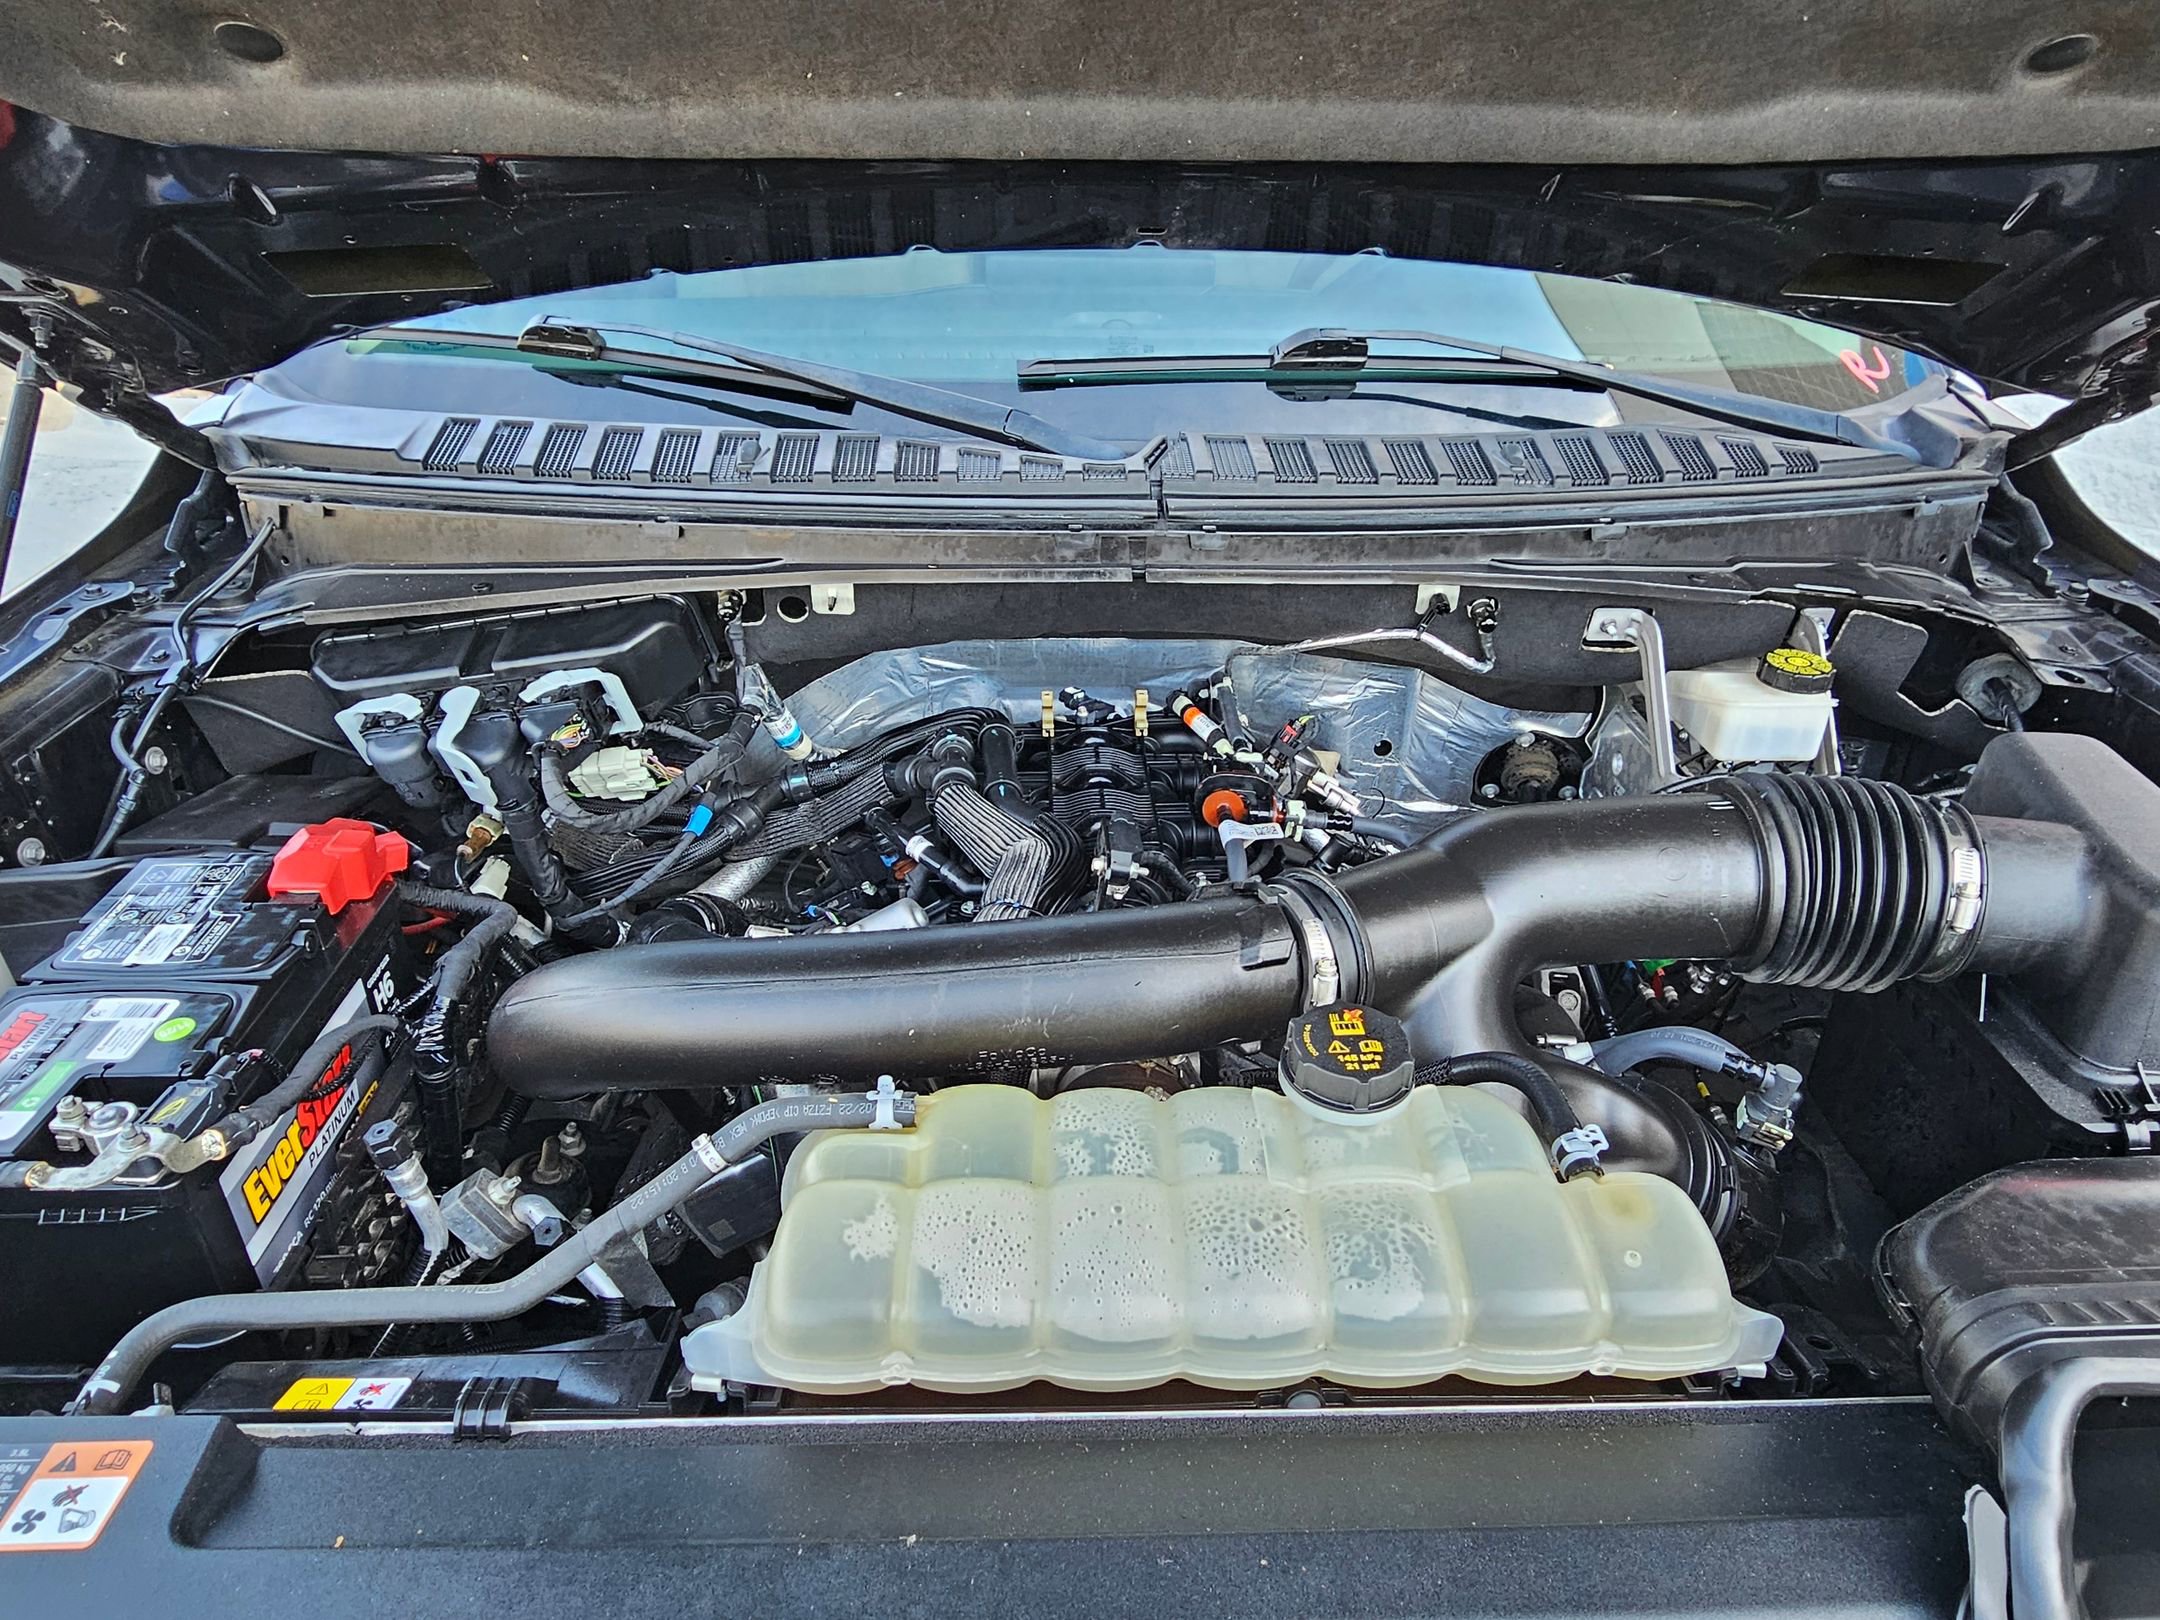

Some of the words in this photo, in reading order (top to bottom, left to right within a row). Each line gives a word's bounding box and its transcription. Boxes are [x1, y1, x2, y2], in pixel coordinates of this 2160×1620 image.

[372, 970, 395, 1013] H6
[9, 1018, 57, 1060] PLATINUM
[1360, 1053, 1382, 1062] kPa
[1362, 1062, 1381, 1070] psi
[308, 1089, 357, 1168] PLATINUM
